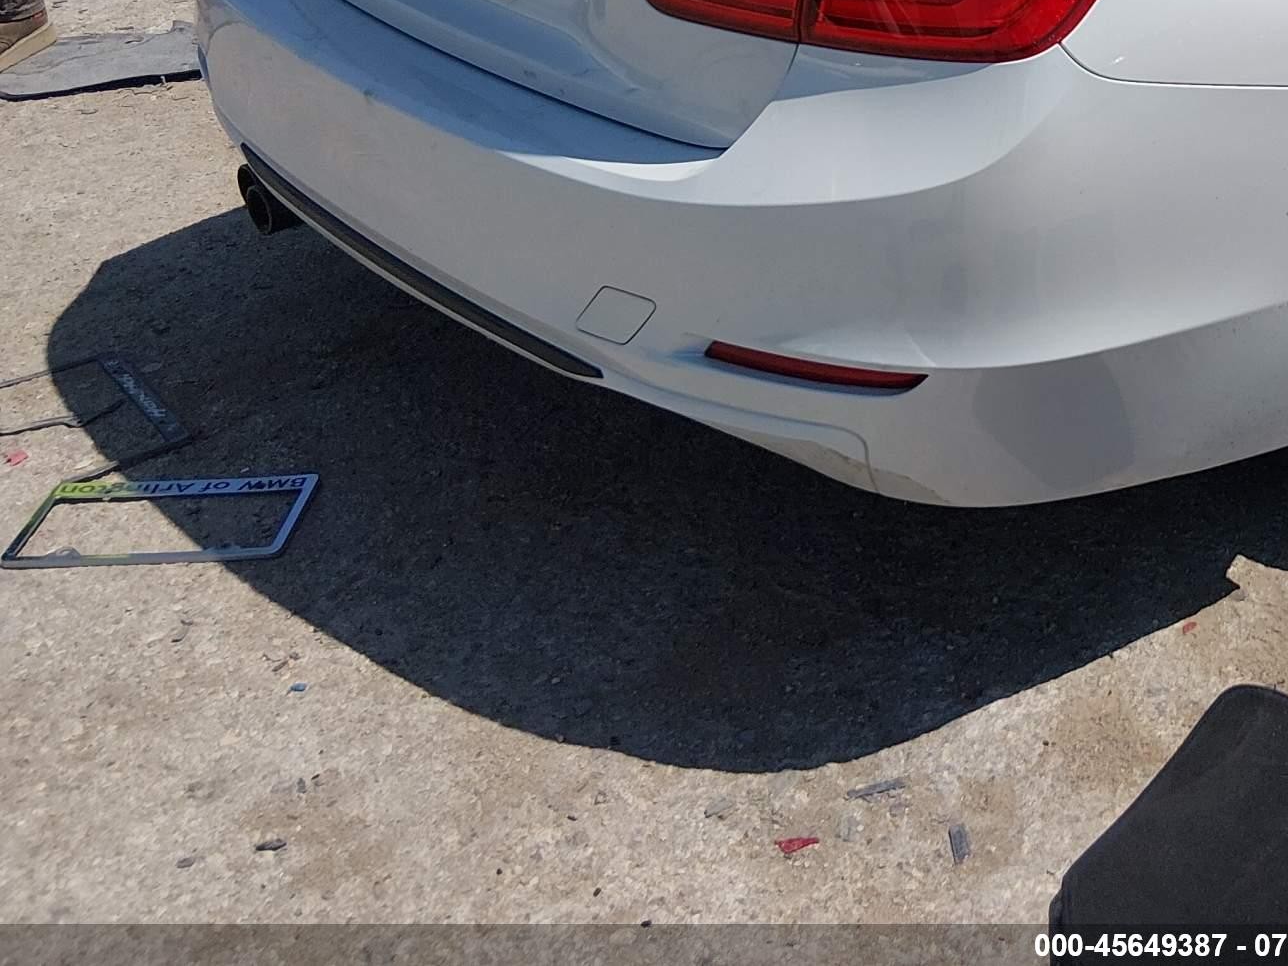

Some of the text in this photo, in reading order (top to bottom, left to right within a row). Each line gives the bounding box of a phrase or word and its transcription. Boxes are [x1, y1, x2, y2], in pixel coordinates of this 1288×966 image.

[60, 476, 307, 498] BMW of Arlington
